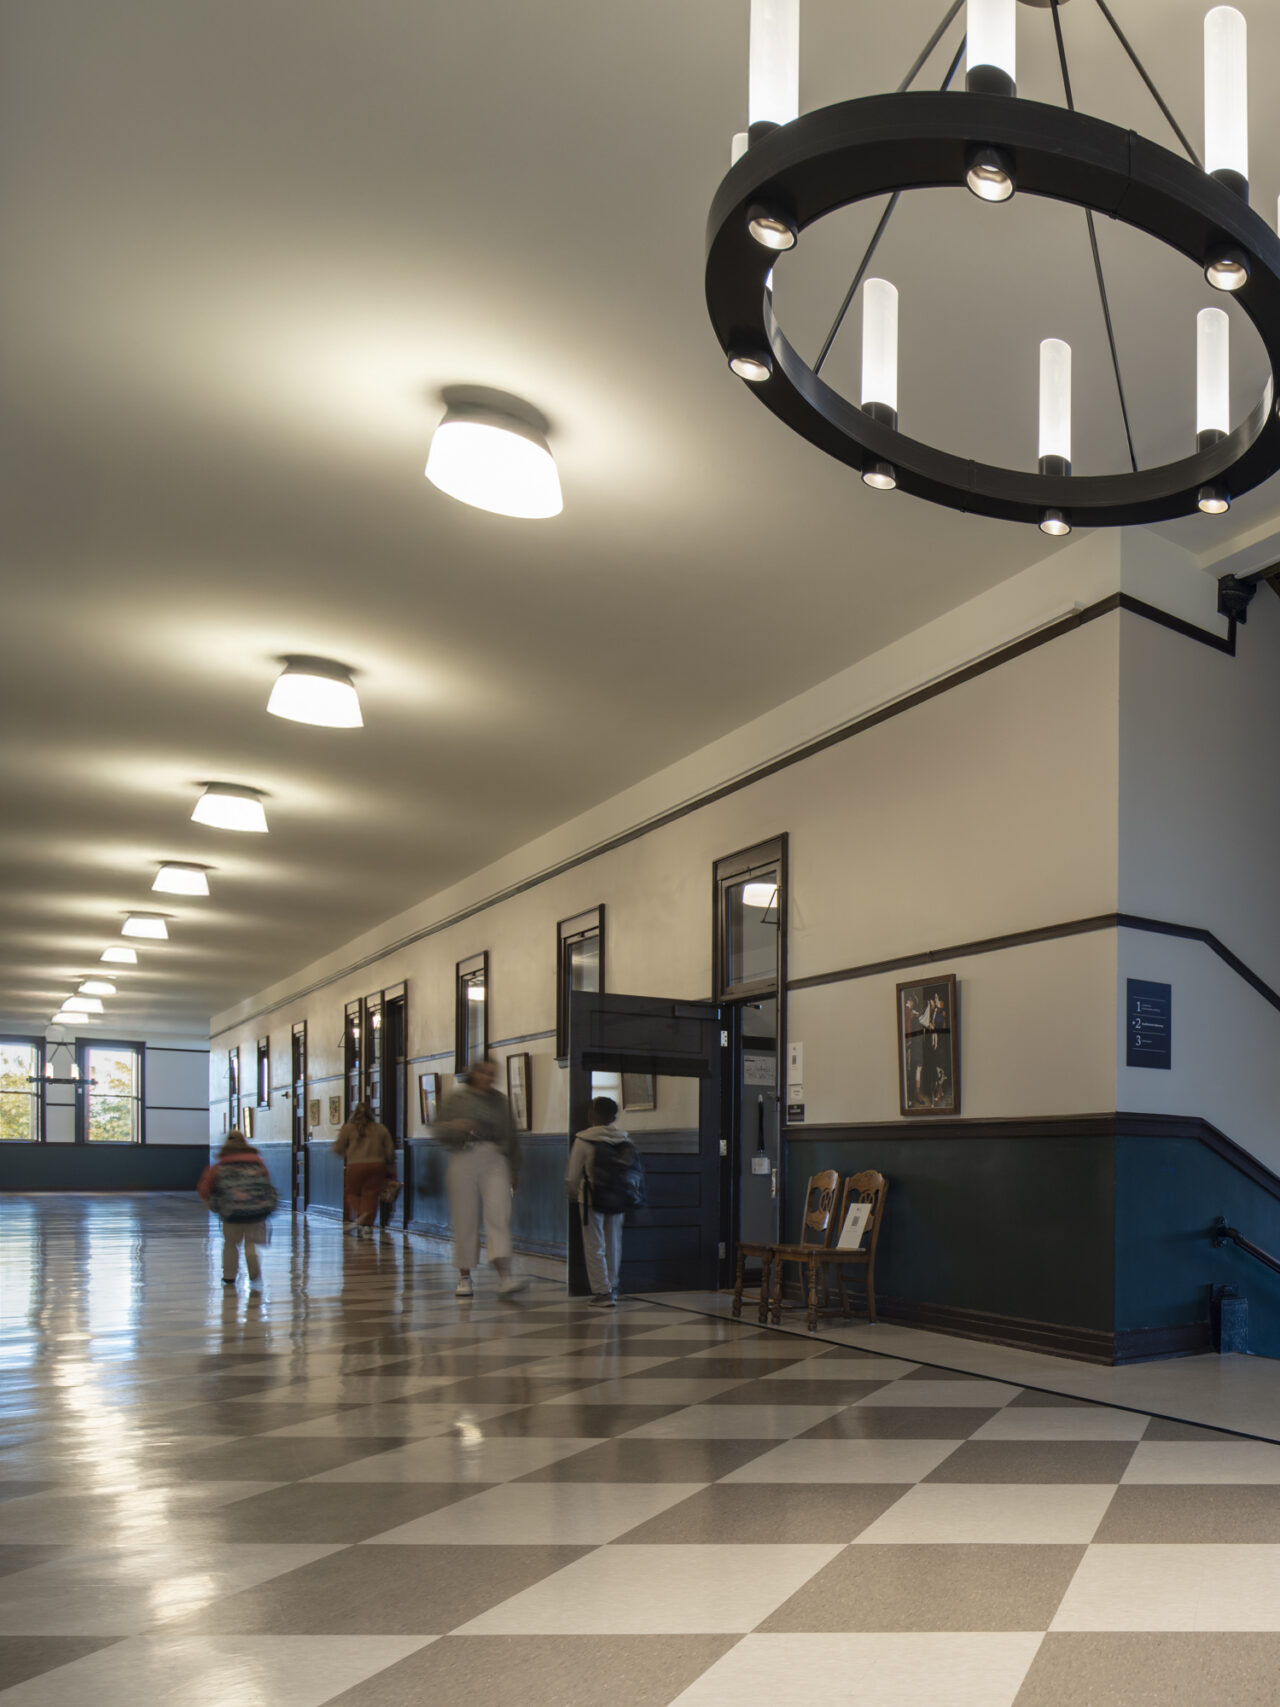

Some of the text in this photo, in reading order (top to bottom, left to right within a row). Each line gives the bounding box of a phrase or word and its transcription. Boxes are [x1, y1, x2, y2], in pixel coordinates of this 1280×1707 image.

[1136, 1001, 1141, 1012] 1
[1136, 1018, 1141, 1029] 2
[1136, 1035, 1141, 1046] 3
